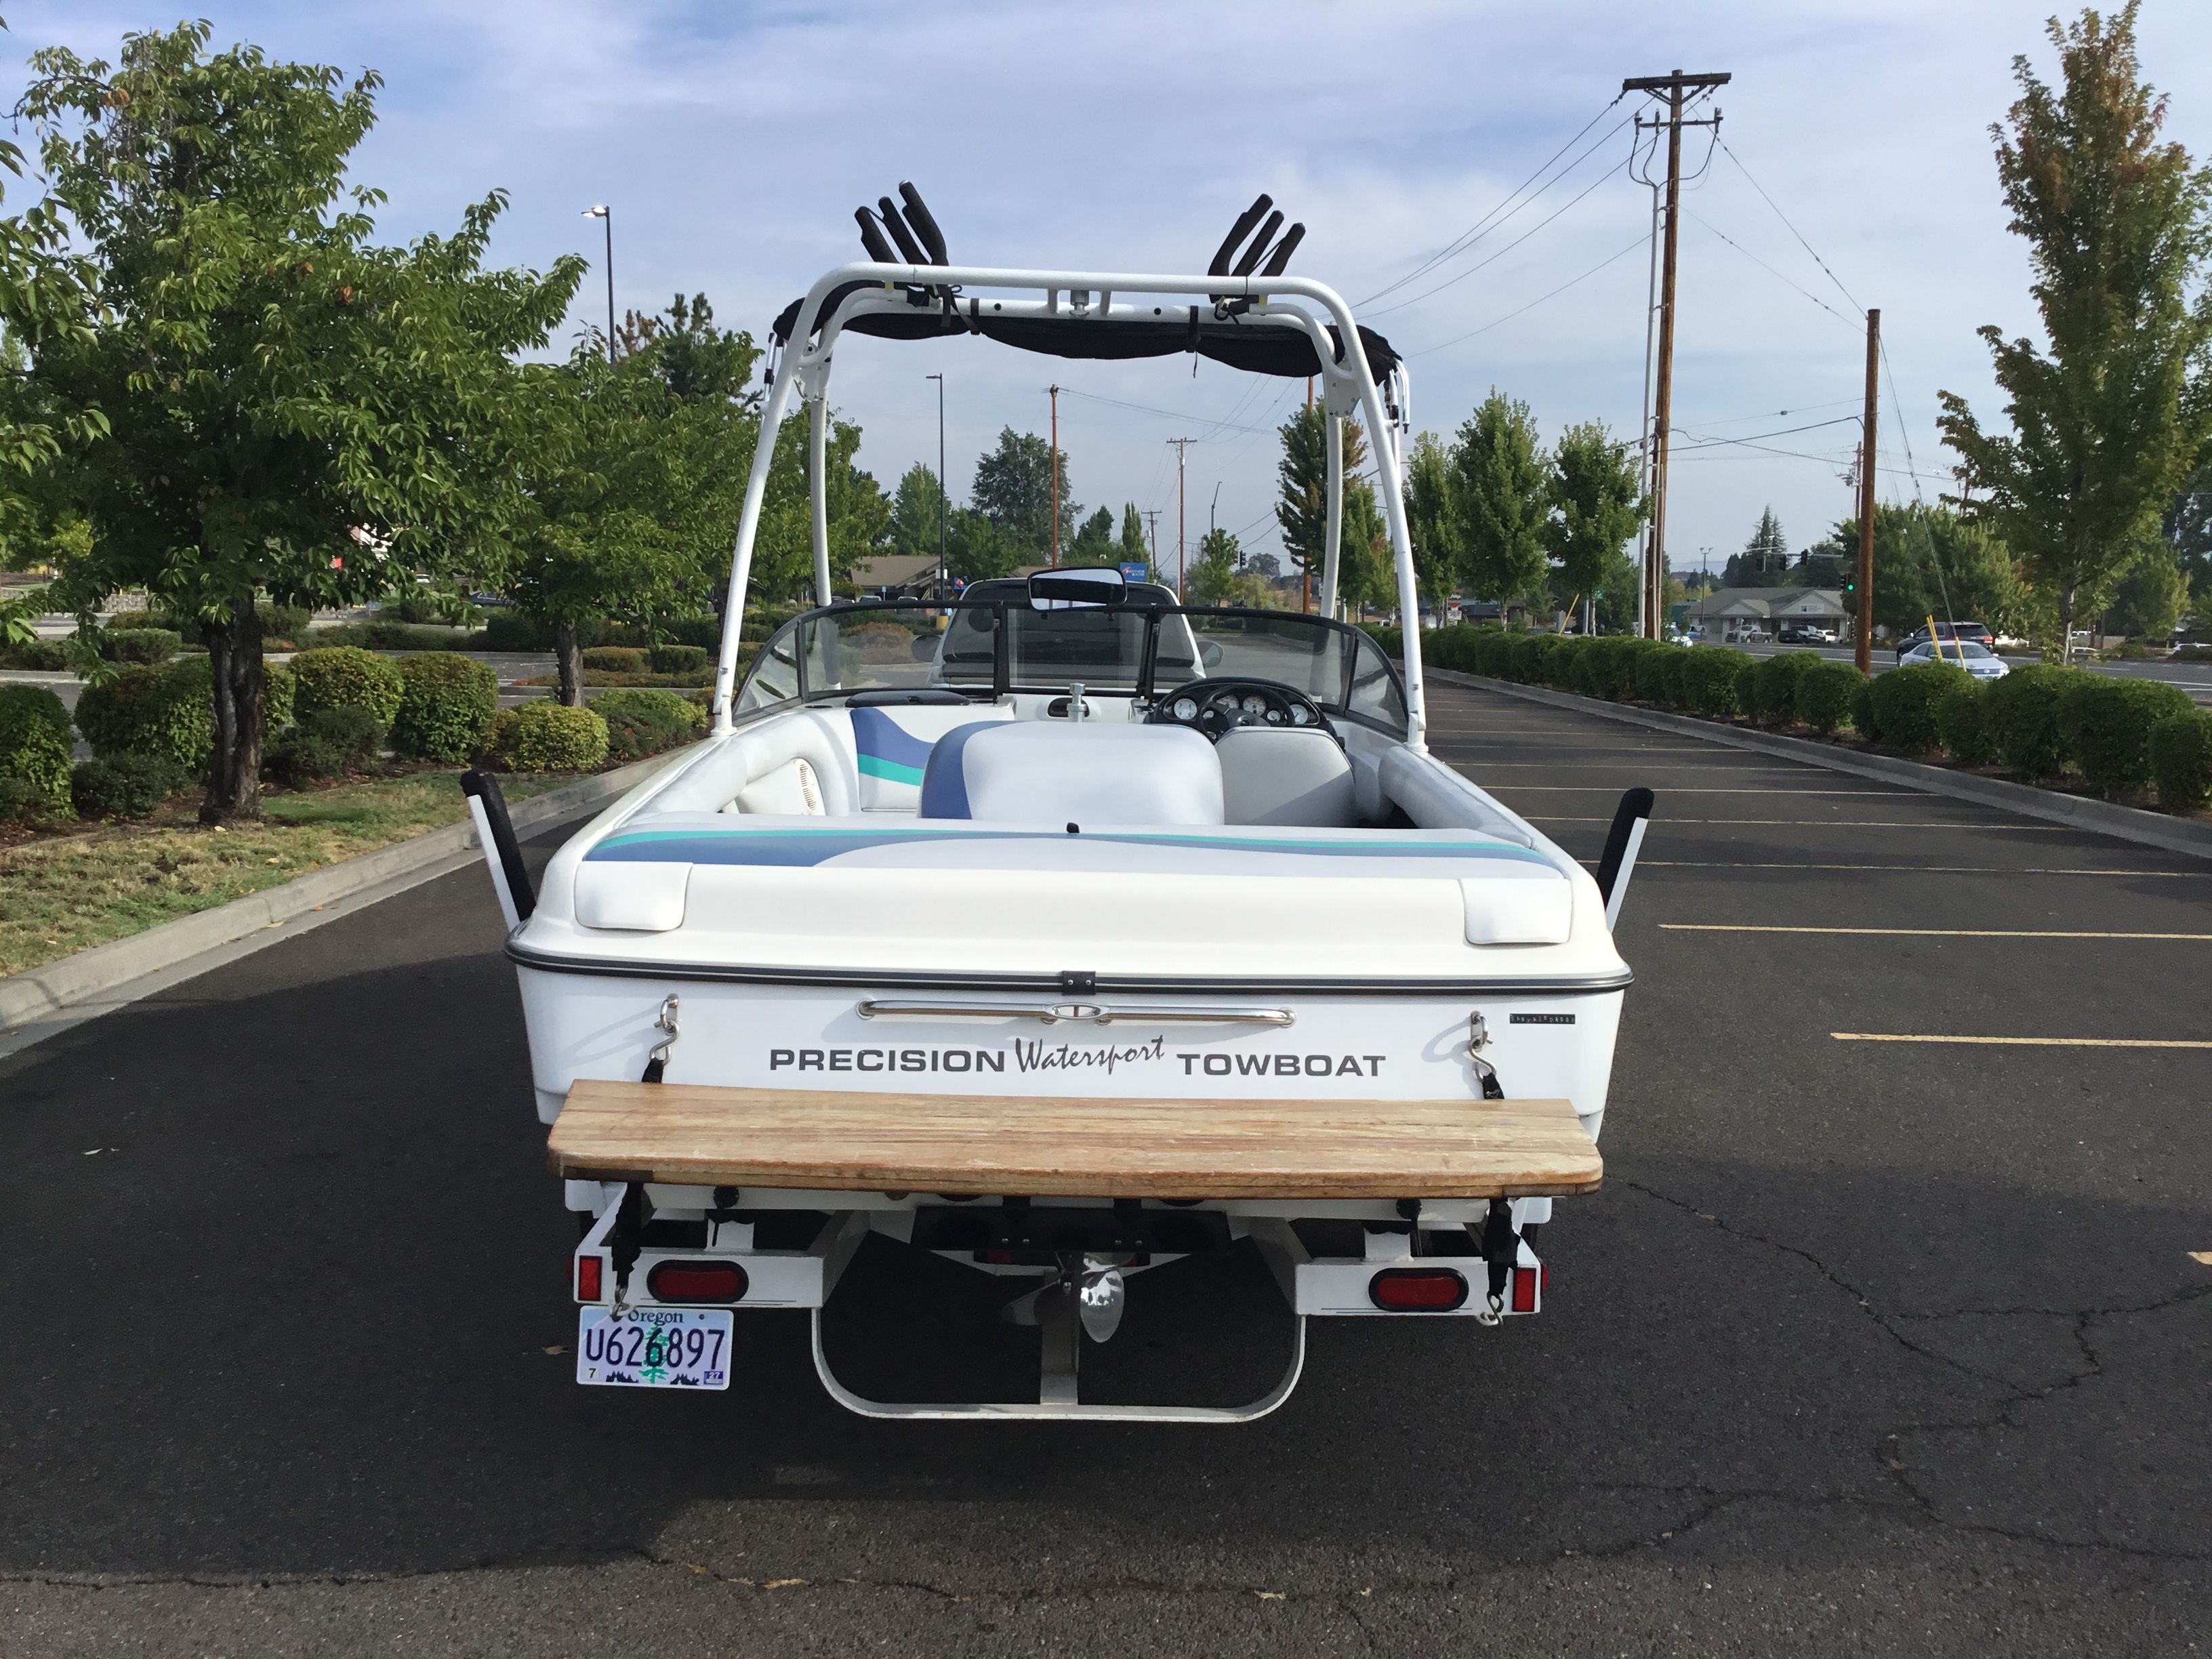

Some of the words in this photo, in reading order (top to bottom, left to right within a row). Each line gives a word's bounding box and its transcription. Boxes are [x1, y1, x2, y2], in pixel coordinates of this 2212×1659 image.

[770, 1049, 1005, 1073] PRECISION
[1015, 1034, 1165, 1076] Watersport
[1176, 1053, 1387, 1078] TOWBOAT
[628, 1310, 684, 1326] Oregon
[586, 1326, 725, 1370] U626897
[588, 1368, 596, 1378] 7
